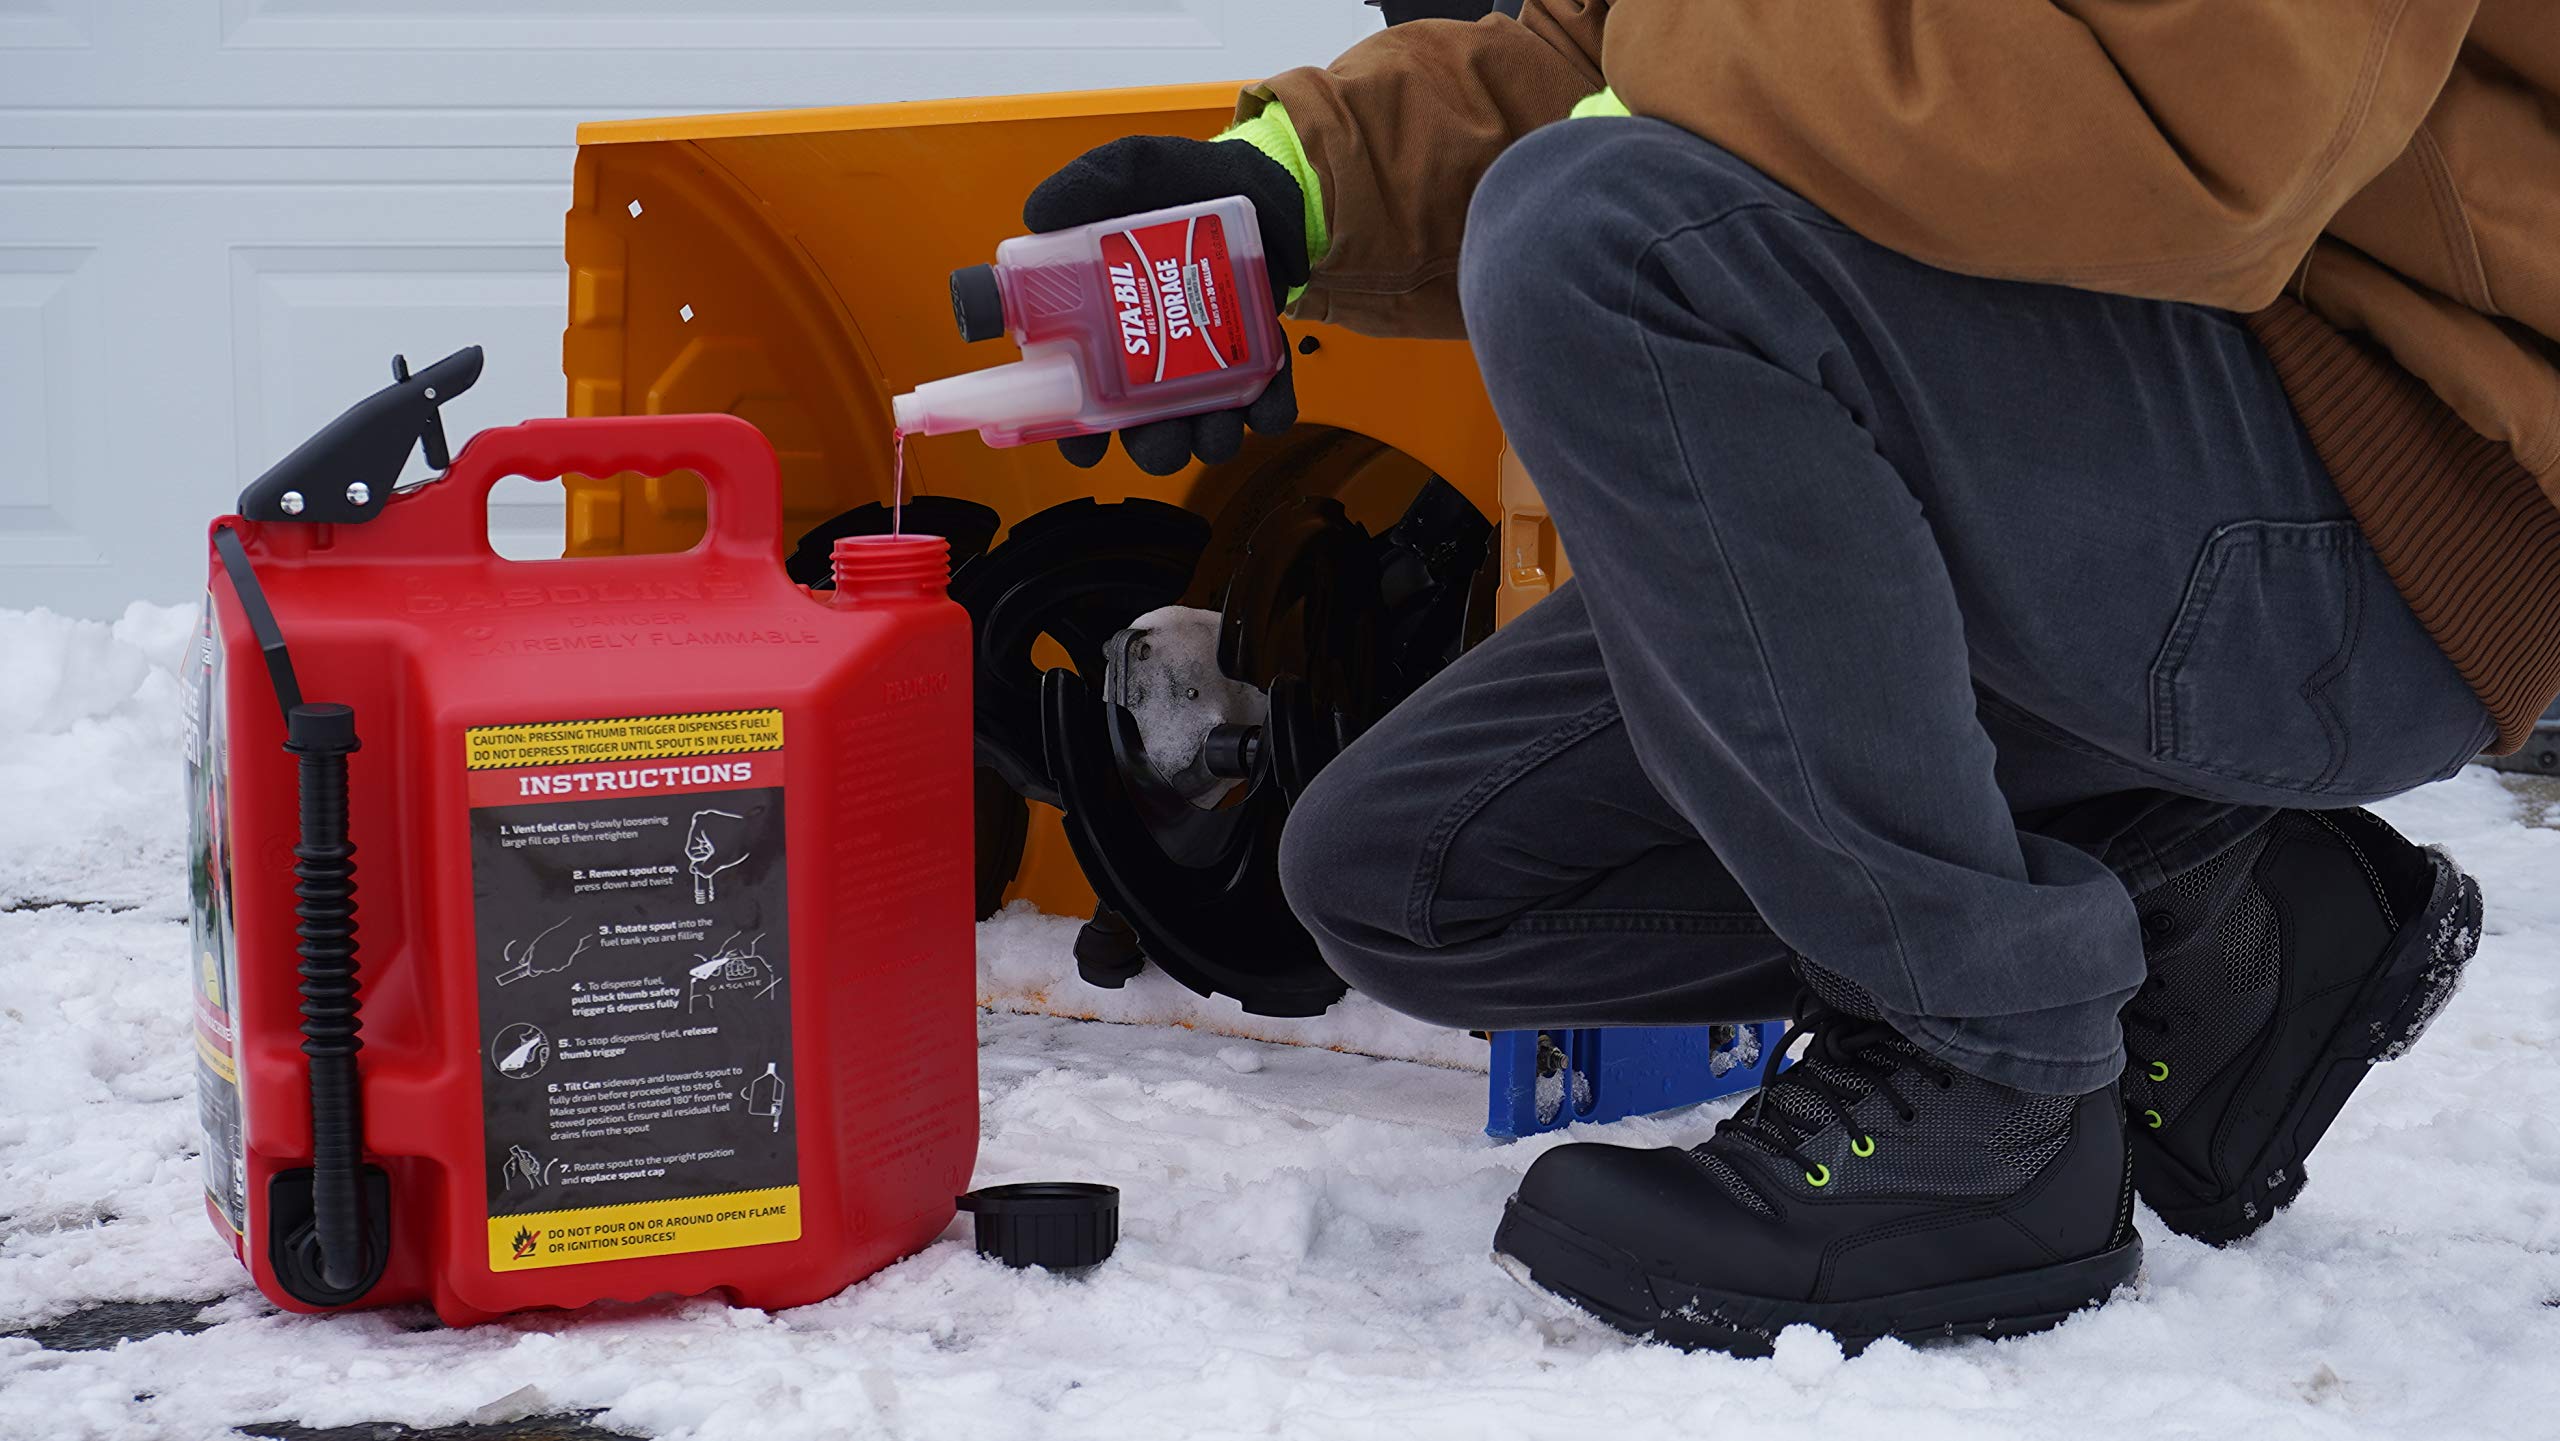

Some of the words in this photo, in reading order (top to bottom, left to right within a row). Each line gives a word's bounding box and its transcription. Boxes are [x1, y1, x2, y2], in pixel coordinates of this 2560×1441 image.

[1200, 257, 1213, 287] GALLONS
[1138, 277, 1154, 316] STABILIZER
[1155, 258, 1192, 339] STORAGE
[1206, 287, 1216, 296] 20
[1109, 262, 1150, 355] STA-BIL
[1147, 317, 1158, 335] FUEL
[405, 580, 751, 615] GASOLINE
[568, 612, 689, 628] DANGER
[650, 630, 820, 646] FLAMMABLE
[473, 733, 526, 746] CAUTION:
[528, 729, 584, 743] PRESSING
[585, 727, 627, 739] THUMB
[628, 724, 676, 736] TRIGGER
[678, 720, 738, 733] DISPENSES
[740, 718, 770, 729] FUEL!
[473, 750, 491, 761] DO
[492, 748, 517, 760] NOT
[518, 745, 569, 758] DEPRESS
[570, 742, 619, 755] TRIGGER
[621, 740, 654, 752] UNTIL
[655, 737, 693, 749] SPOUT
[694, 736, 705, 747] IS
[706, 736, 719, 746] IN
[721, 734, 748, 745] FUEL
[749, 732, 778, 743] TANK
[519, 762, 752, 796] INSTRUCTIONS
[500, 825, 510, 835] 1.
[512, 824, 536, 834] Vent
[536, 822, 558, 833] fuel
[557, 823, 577, 832] can
[577, 821, 590, 832] by
[590, 818, 622, 830] slowly
[623, 816, 669, 828] loosening
[501, 837, 527, 849] large
[528, 836, 542, 845] fill
[542, 836, 561, 846] cap
[561, 834, 570, 843] &
[571, 832, 594, 843] then
[594, 829, 639, 843] retighten
[573, 870, 586, 880] 2.
[589, 868, 628, 879] Remove
[629, 866, 657, 877] spout
[574, 883, 601, 893] press
[602, 880, 629, 890] down
[629, 878, 648, 888] and
[649, 876, 674, 886] twist
[599, 925, 612, 935] 3.
[615, 923, 648, 934] Rotate
[649, 921, 677, 933] spout
[678, 919, 697, 929] into
[697, 918, 713, 927] the
[600, 937, 619, 947] fuel
[620, 936, 641, 946] tank
[642, 936, 660, 945] you
[660, 934, 677, 942] are
[677, 930, 705, 942] filling
[571, 982, 586, 992] 4.
[588, 981, 600, 991] To
[600, 979, 643, 991] dispense
[571, 994, 591, 1006] pull
[592, 992, 616, 1003] back
[616, 989, 649, 1001] thumb
[649, 986, 681, 999] safety
[572, 1005, 606, 1018] trigger
[606, 1004, 615, 1013] &
[616, 1001, 656, 1014] depress
[656, 998, 679, 1010] fully
[558, 1038, 572, 1048] 5.
[575, 1037, 586, 1047] To
[587, 1036, 609, 1047] stop
[610, 1031, 660, 1045] dispensing
[682, 1025, 718, 1037] release
[559, 1049, 592, 1060] thumb
[592, 1046, 627, 1059] trigger
[547, 1083, 561, 1093] 6.
[564, 1081, 582, 1092] Tilt
[582, 1080, 602, 1090] Can
[602, 1076, 646, 1089] sideways
[646, 1074, 665, 1084] and
[666, 1070, 704, 1082] towards
[705, 1068, 731, 1079] spout
[732, 1067, 743, 1075] to
[548, 1094, 571, 1107] fully
[571, 1092, 597, 1103] drain
[597, 1089, 629, 1101] before
[629, 1084, 681, 1099] proceeding
[681, 1084, 692, 1092] to
[692, 1082, 714, 1092] step
[714, 1079, 723, 1089] 6.
[549, 1106, 576, 1117] Make
[576, 1106, 598, 1115] sure
[598, 1102, 626, 1114] spout
[627, 1101, 636, 1110] is
[637, 1097, 672, 1109] rotated
[693, 1092, 717, 1103] from
[717, 1090, 733, 1100] the
[549, 1118, 586, 1129] stowed
[586, 1113, 627, 1127] position.
[627, 1110, 660, 1122] Ensure
[660, 1109, 673, 1118] all
[674, 1105, 711, 1117] residual
[712, 1102, 730, 1113] fuel
[550, 1130, 581, 1141] drains
[581, 1127, 605, 1138] from
[605, 1126, 622, 1136] the
[622, 1124, 650, 1135] spout
[559, 1163, 571, 1174] 7.
[574, 1161, 606, 1172] Rotate
[606, 1159, 634, 1171] spout
[634, 1158, 645, 1166] to
[646, 1155, 662, 1165] the
[663, 1152, 697, 1165] upright
[697, 1148, 735, 1161] position
[561, 1176, 579, 1185] and
[580, 1172, 617, 1185] replace
[618, 1169, 647, 1181] spout
[647, 1168, 666, 1178] cap
[548, 1228, 565, 1240] DO
[567, 1226, 592, 1238] NOT
[594, 1222, 626, 1235] POUR
[628, 1220, 645, 1231] ON
[647, 1219, 664, 1229] OR
[665, 1213, 714, 1227] AROUND
[716, 1210, 747, 1222] OPEN
[748, 1205, 787, 1218] FLAME
[548, 1243, 565, 1253] OR
[567, 1237, 619, 1251] IGNITION
[621, 1231, 676, 1246] SOURCES!
